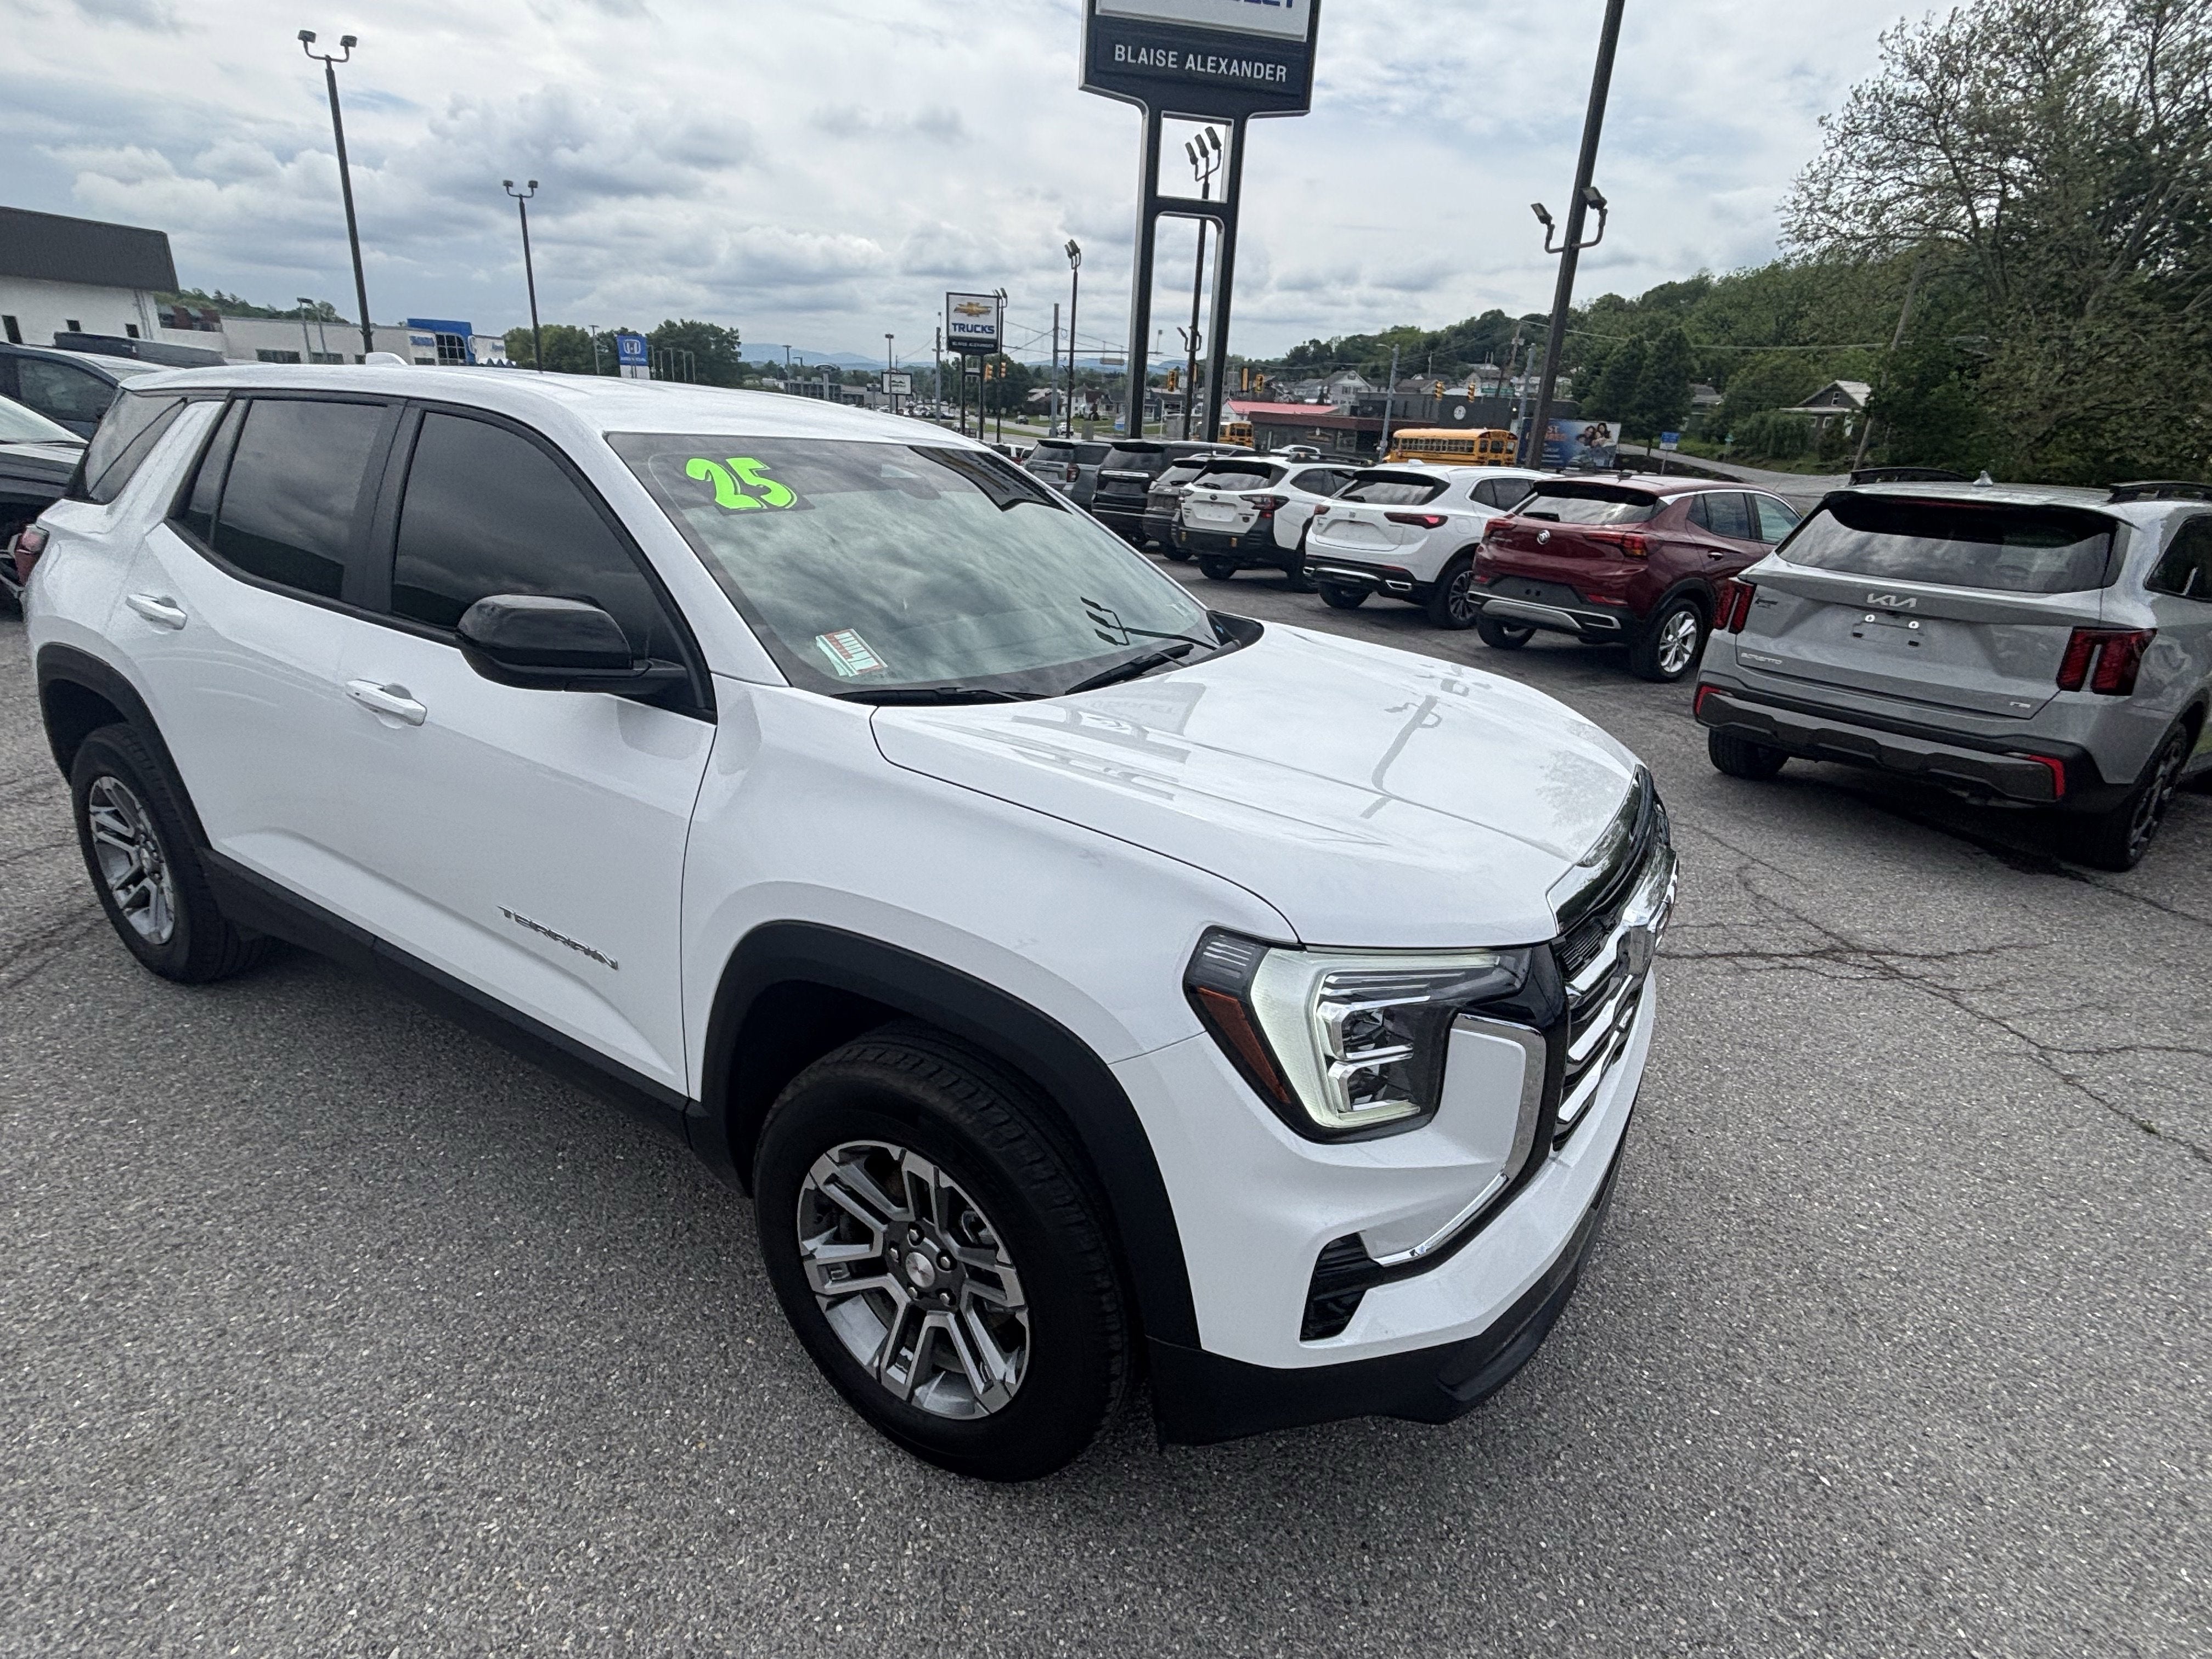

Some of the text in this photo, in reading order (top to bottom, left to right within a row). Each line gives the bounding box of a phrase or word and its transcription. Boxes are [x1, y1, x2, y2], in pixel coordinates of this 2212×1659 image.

[1114, 44, 1286, 83] BLAISE ALEXANDER
[952, 323, 995, 334] TRUCKS
[686, 457, 798, 509] 25
[1867, 593, 1917, 608] KIA
